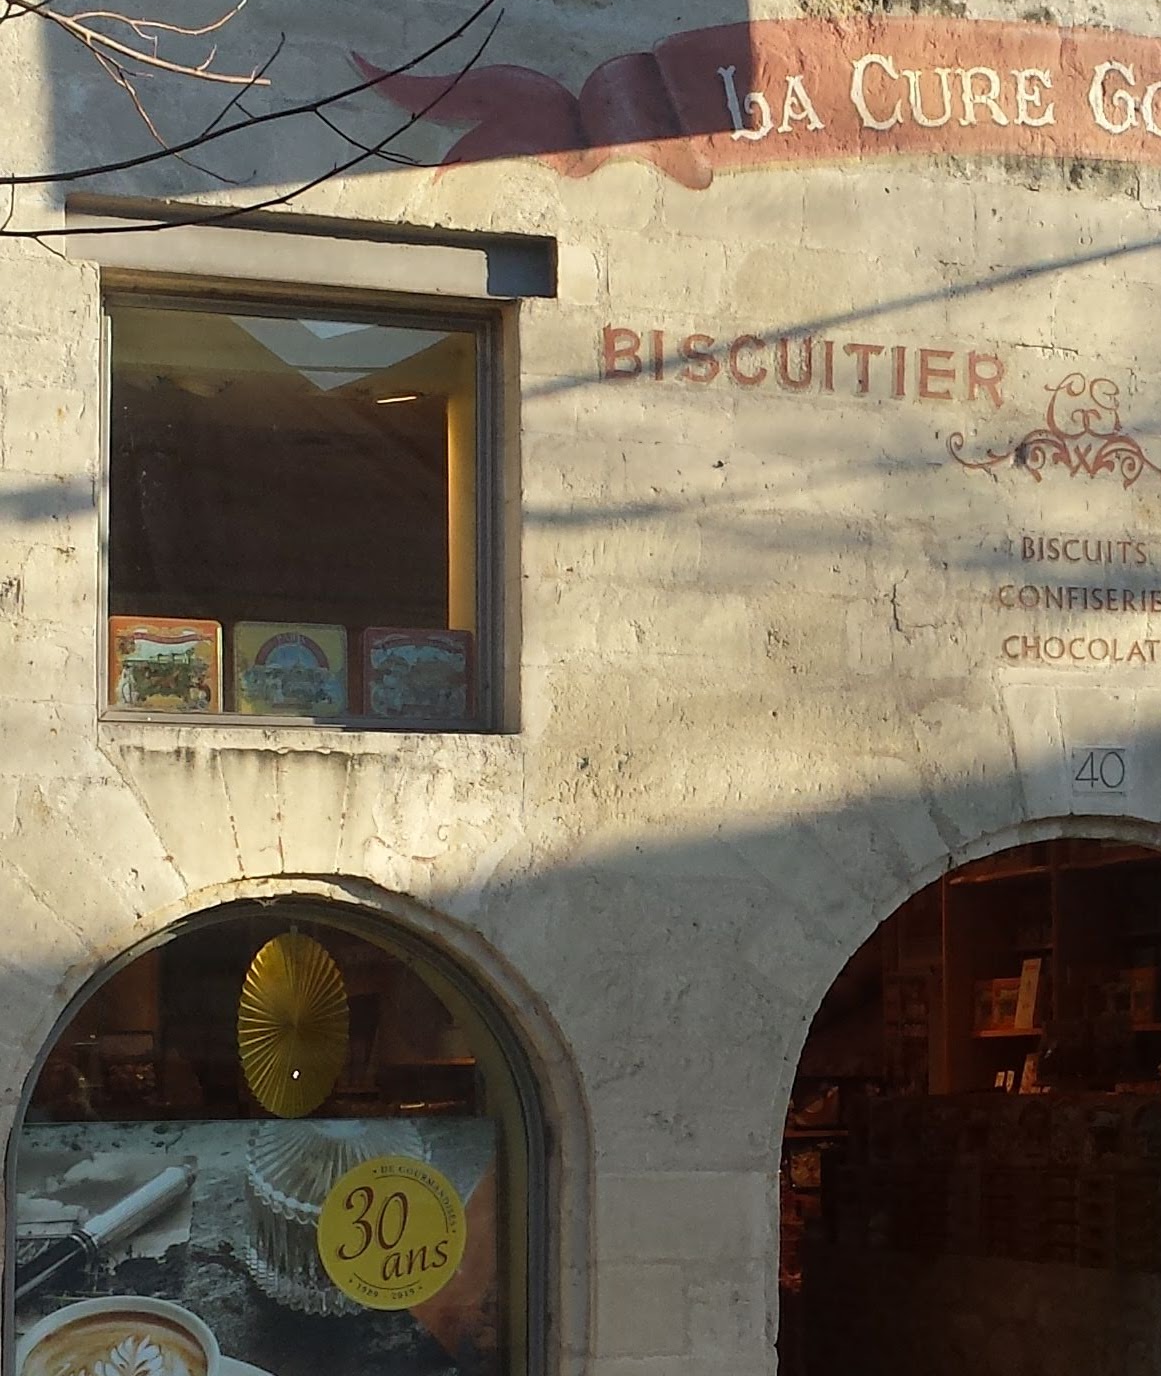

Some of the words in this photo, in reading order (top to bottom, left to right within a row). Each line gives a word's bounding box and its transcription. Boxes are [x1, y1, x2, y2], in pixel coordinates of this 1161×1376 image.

[717, 64, 825, 141] LA
[850, 53, 1056, 130] CURE
[602, 325, 1006, 407] BISCUITIER
[1021, 536, 1149, 565] BISCUITS
[1074, 751, 1127, 790] 40
[337, 1185, 409, 1261] 30
[382, 1239, 449, 1281] ans
